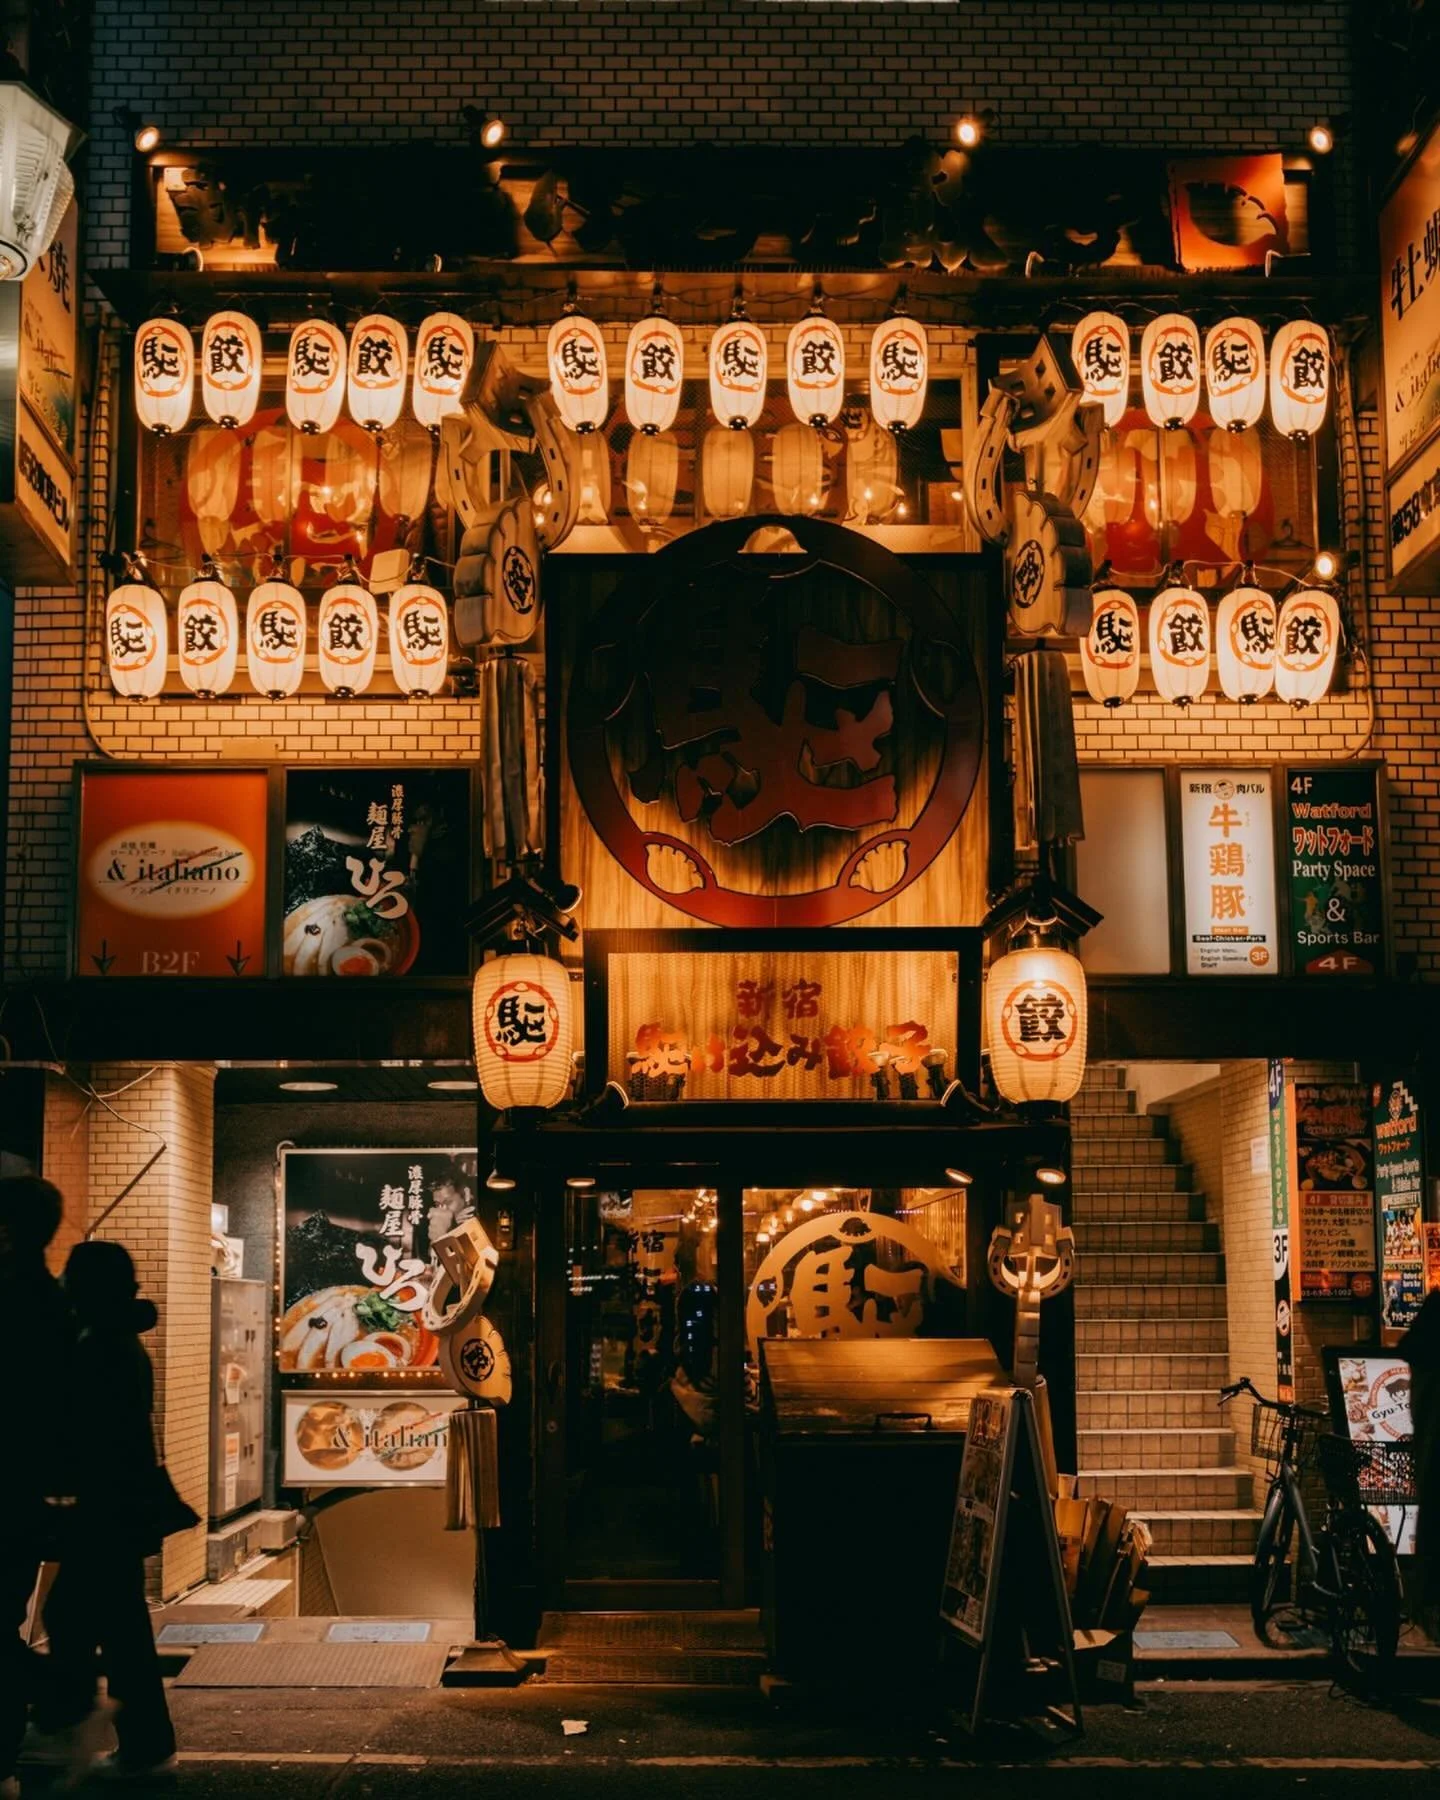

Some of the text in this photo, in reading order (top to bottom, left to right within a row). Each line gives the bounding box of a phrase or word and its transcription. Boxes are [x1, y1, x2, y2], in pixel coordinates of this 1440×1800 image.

[1236, 783, 1265, 795] 肉バル
[1290, 777, 1313, 795] 4F
[1291, 802, 1372, 820] Watford
[1292, 825, 1374, 857] ワットフォード
[106, 858, 240, 882] & italiano
[1292, 860, 1375, 881] Party Space
[346, 855, 409, 920] ひろ
[1326, 898, 1346, 922] &
[1297, 931, 1380, 948] Sports Bar
[141, 952, 200, 975] B2F
[1251, 950, 1268, 961] 3F
[1318, 956, 1358, 970] 4F
[737, 979, 822, 1019] 新宿
[1268, 1066, 1281, 1098] 4F
[1273, 1234, 1288, 1263] 3F
[355, 1242, 428, 1312] ひろ
[1353, 1280, 1372, 1291] 3F
[332, 1426, 350, 1448] &
